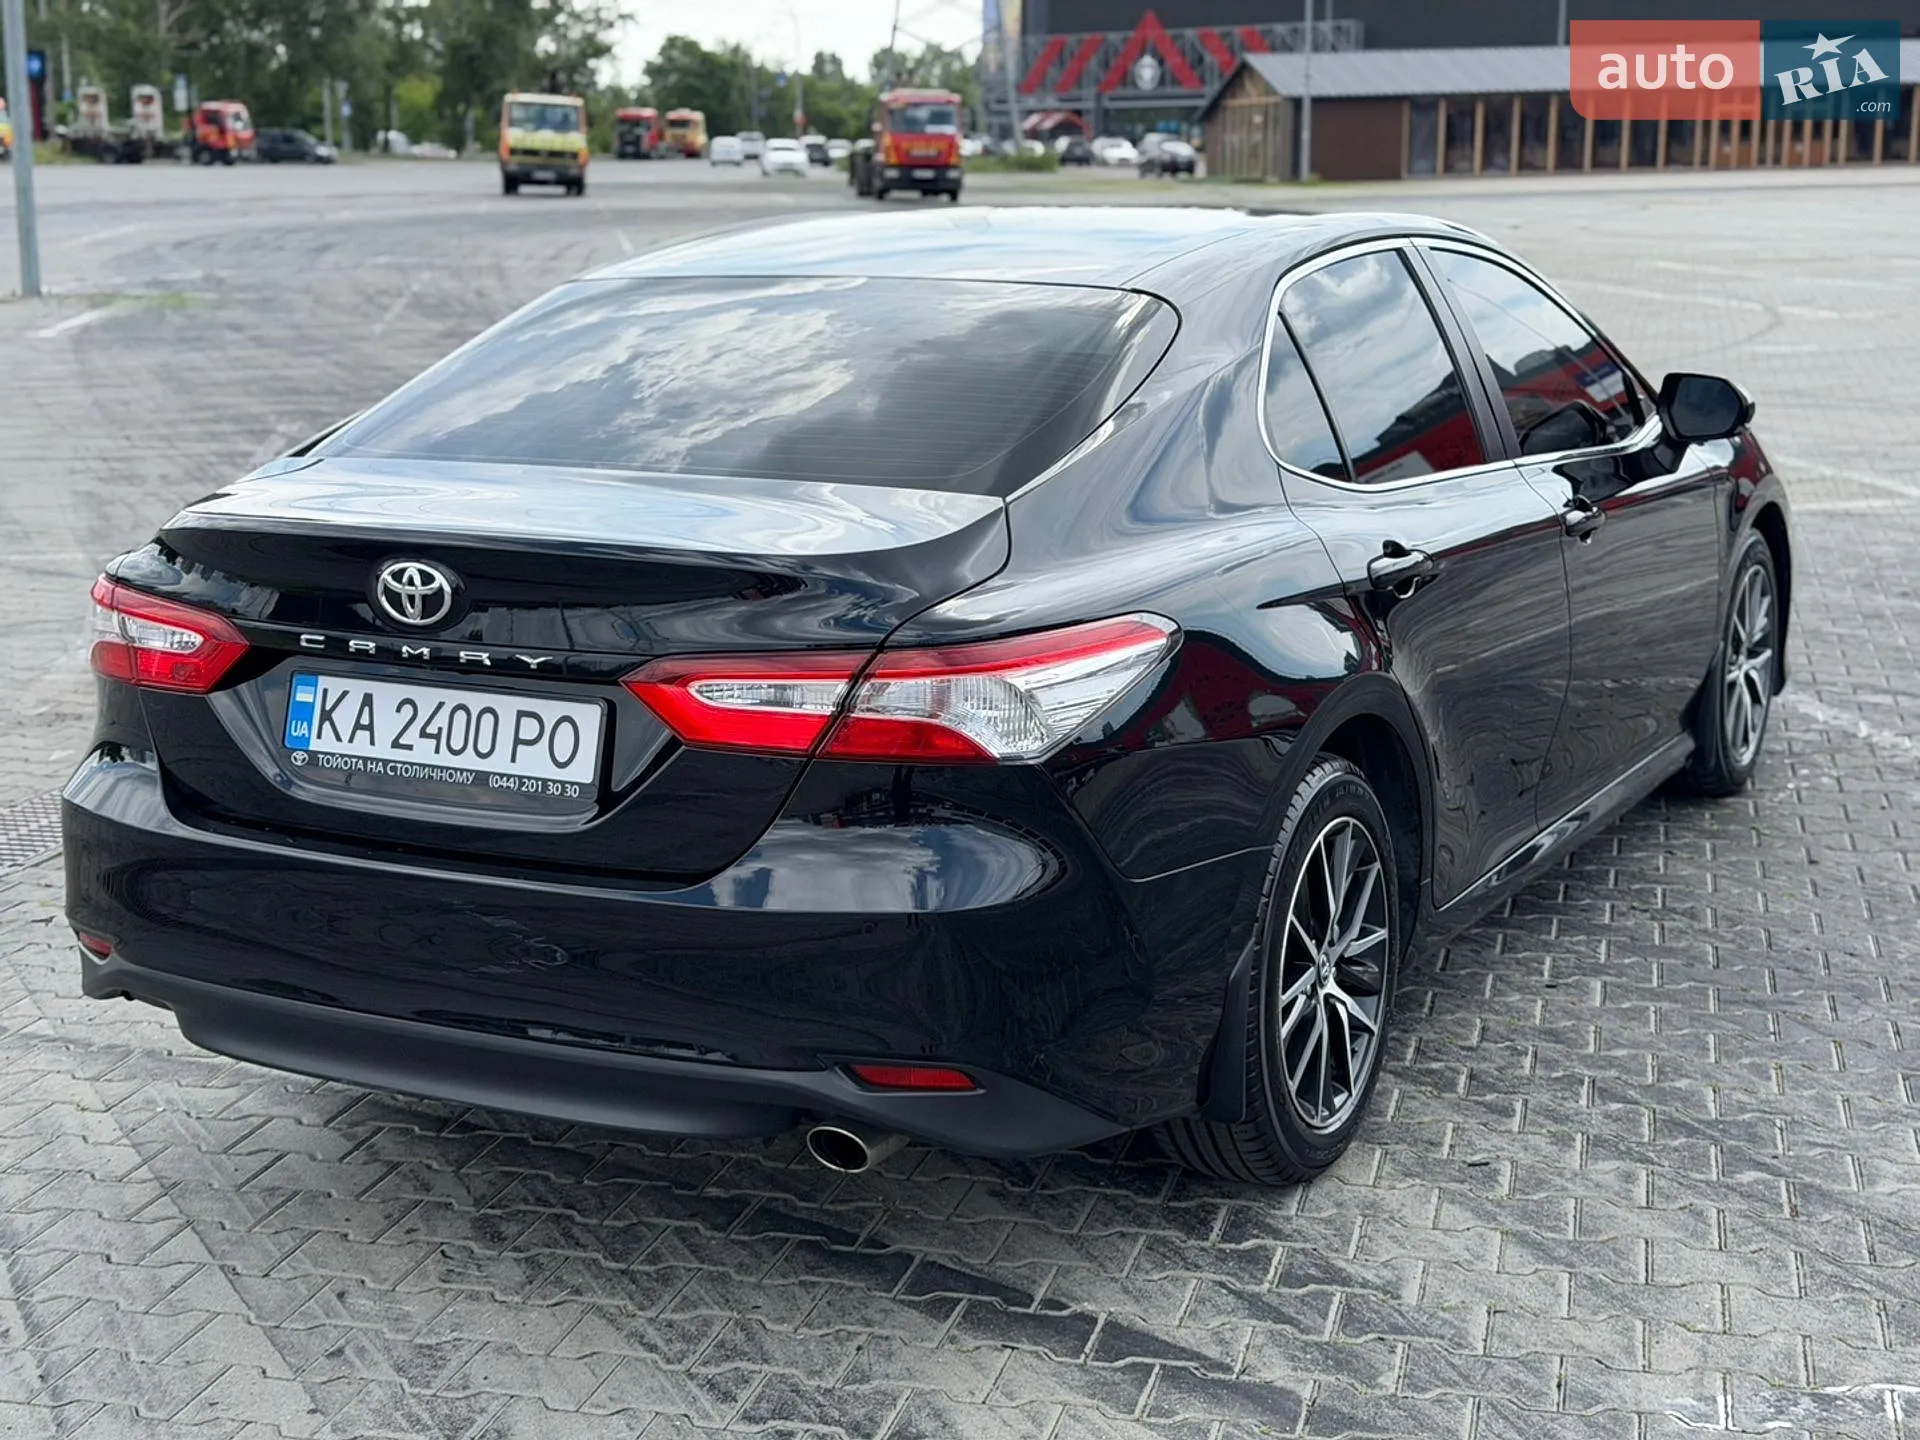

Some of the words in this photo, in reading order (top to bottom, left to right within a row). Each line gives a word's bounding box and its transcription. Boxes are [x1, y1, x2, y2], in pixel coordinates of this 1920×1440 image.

[300, 633, 553, 669] CAMRY
[290, 719, 309, 738] UA
[316, 687, 376, 747] KA
[391, 698, 500, 760] 2400
[509, 709, 580, 770] PO
[316, 754, 364, 772] ТОЙОТА
[366, 761, 384, 775] НА
[386, 763, 476, 785] СТОЛИЧНОМУ
[488, 774, 519, 792] (044)
[521, 779, 542, 793] 201
[545, 782, 562, 796] 30
[564, 785, 580, 798] 30
